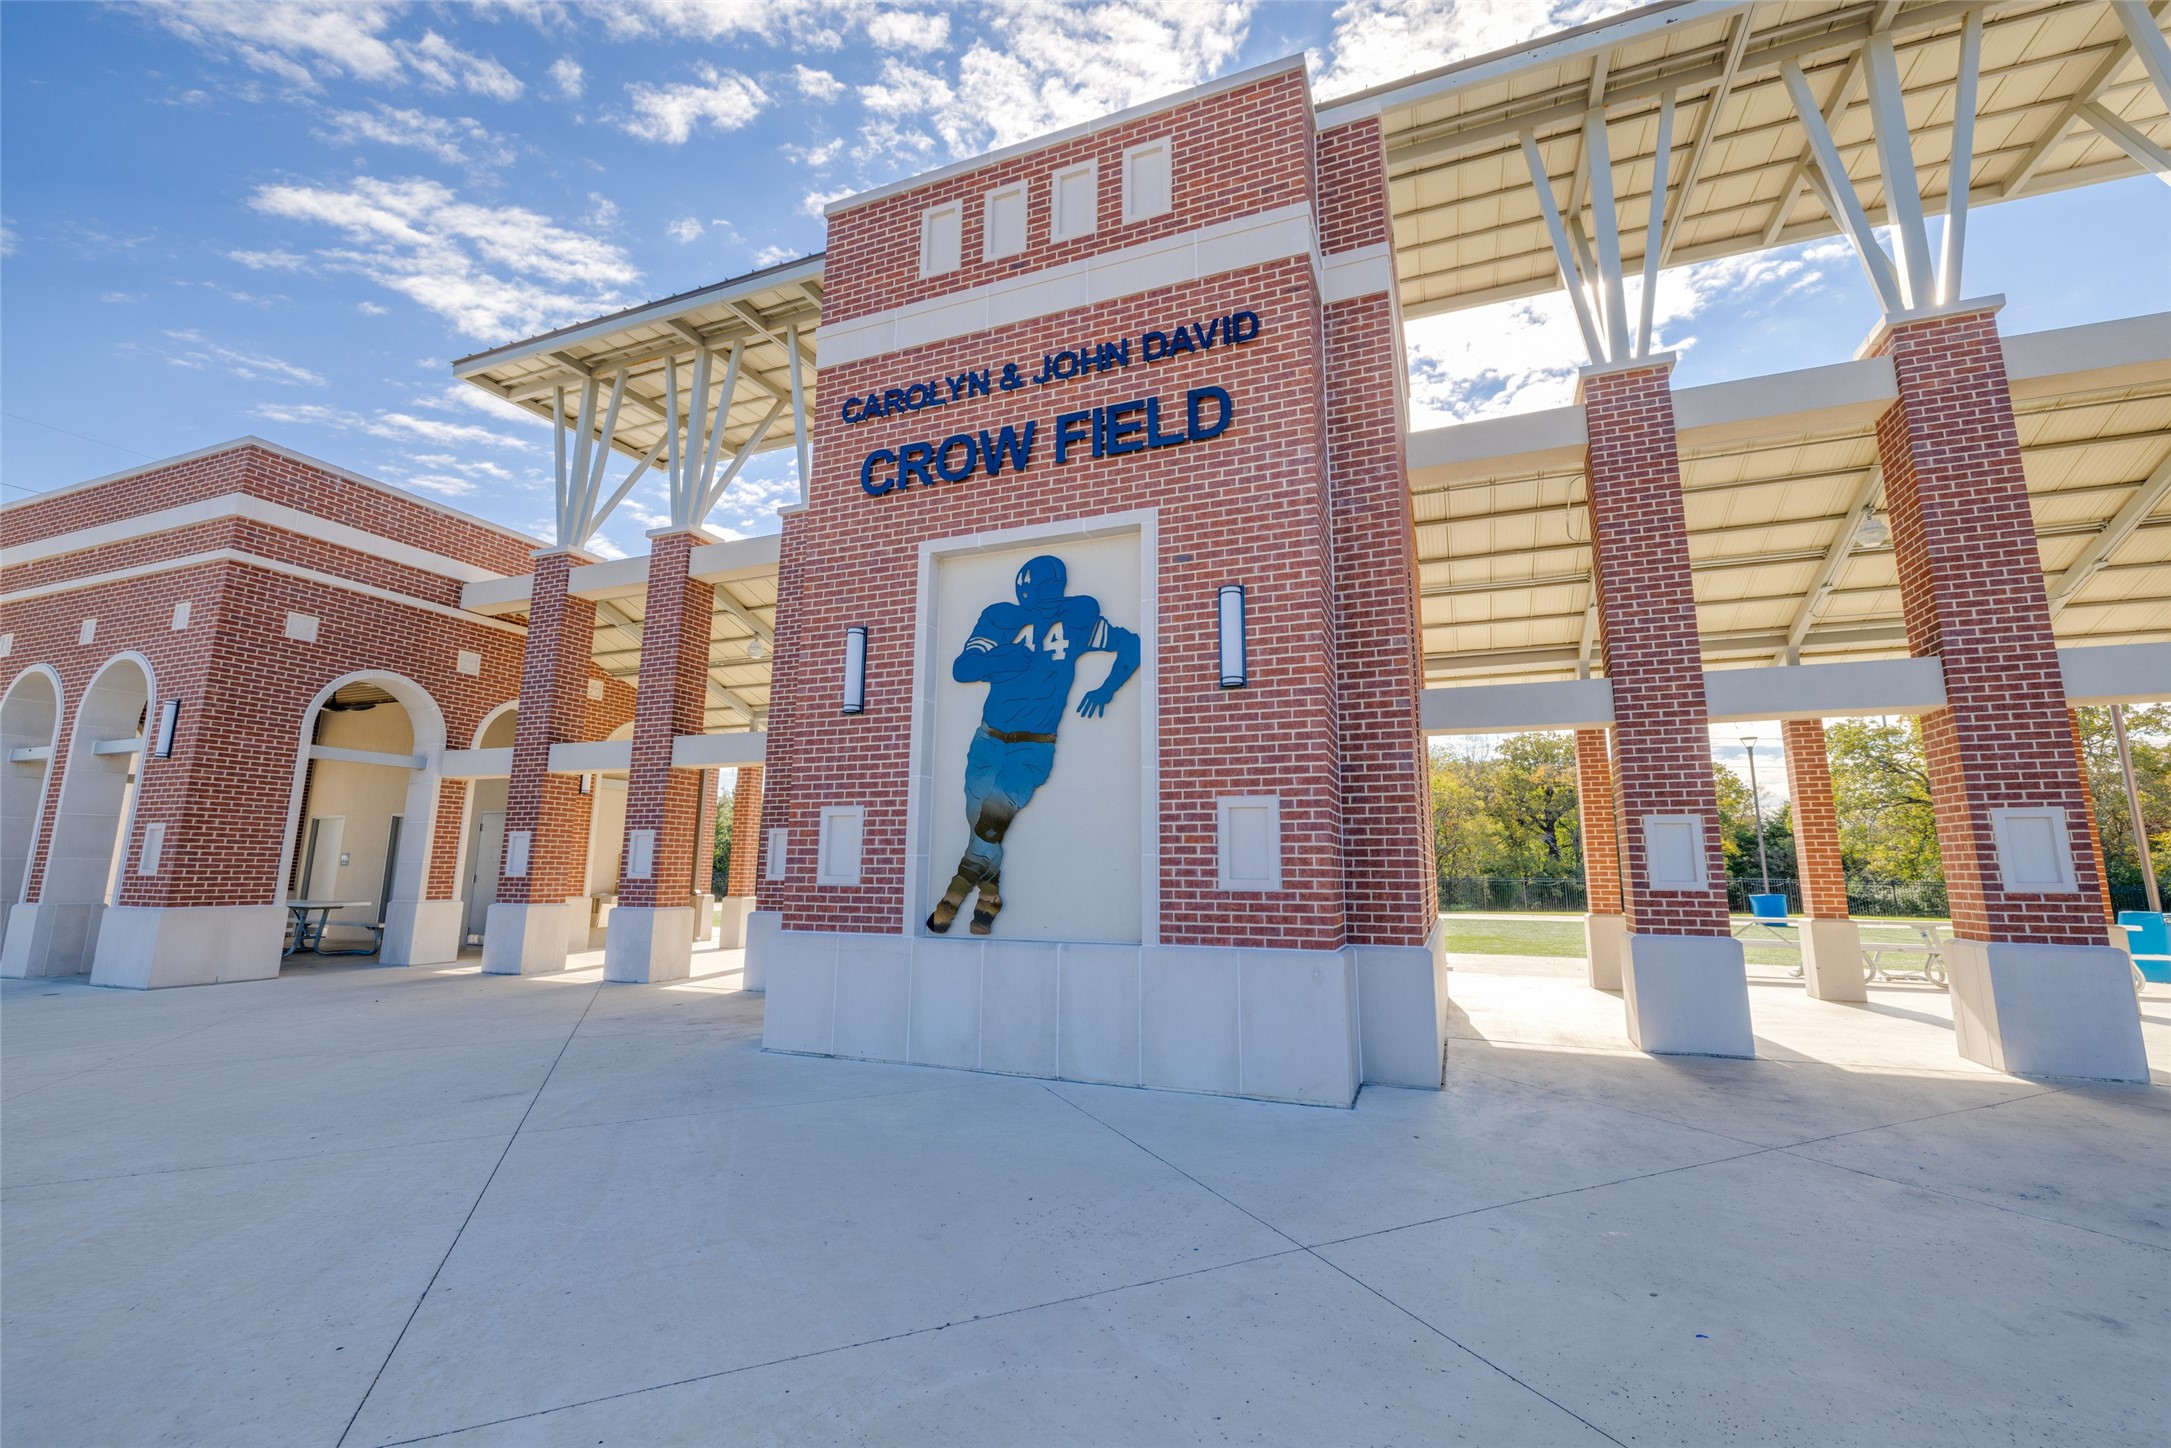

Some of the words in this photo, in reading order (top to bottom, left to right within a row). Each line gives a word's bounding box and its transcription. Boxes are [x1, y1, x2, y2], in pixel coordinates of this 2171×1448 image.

[841, 368, 991, 425] CAROLYN
[1000, 363, 1023, 392] &
[1034, 338, 1129, 386] JOHN
[1142, 311, 1260, 363] DAVID
[860, 420, 1037, 497] CROW
[1055, 386, 1234, 464] FIELD
[1016, 569, 1032, 587] 44
